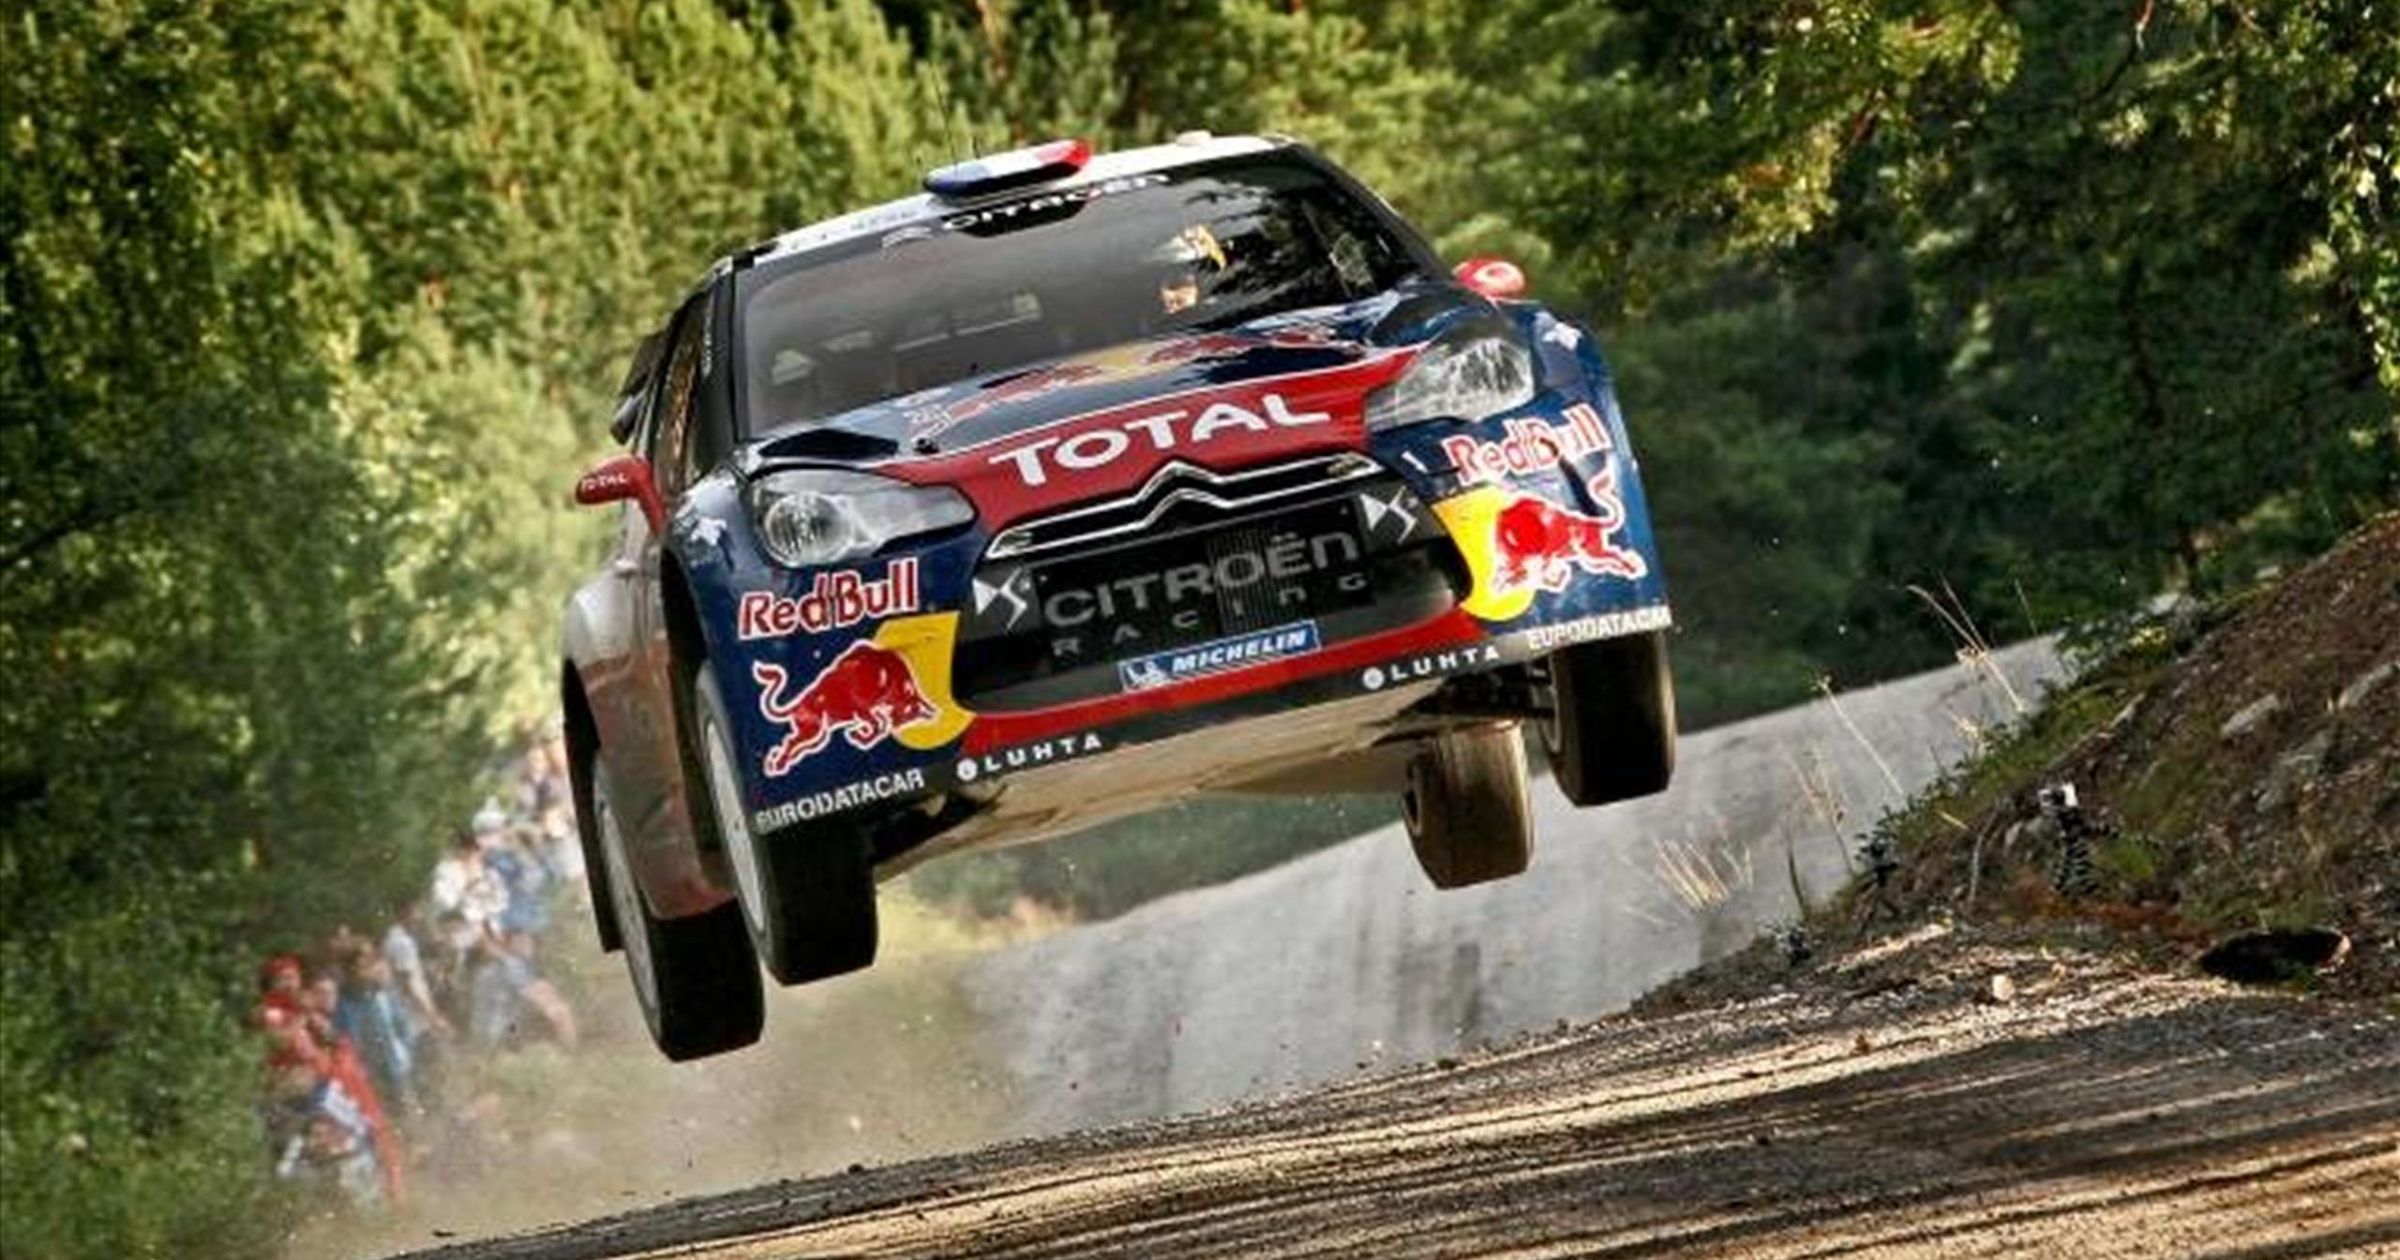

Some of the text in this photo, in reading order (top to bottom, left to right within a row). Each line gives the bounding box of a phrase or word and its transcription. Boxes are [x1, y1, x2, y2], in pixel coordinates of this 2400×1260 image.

[990, 394, 1330, 487] TOTAL
[1172, 629, 1307, 673] MICHELIN
[1391, 645, 1500, 681] LUHTA
[984, 733, 1102, 772] LUHTA
